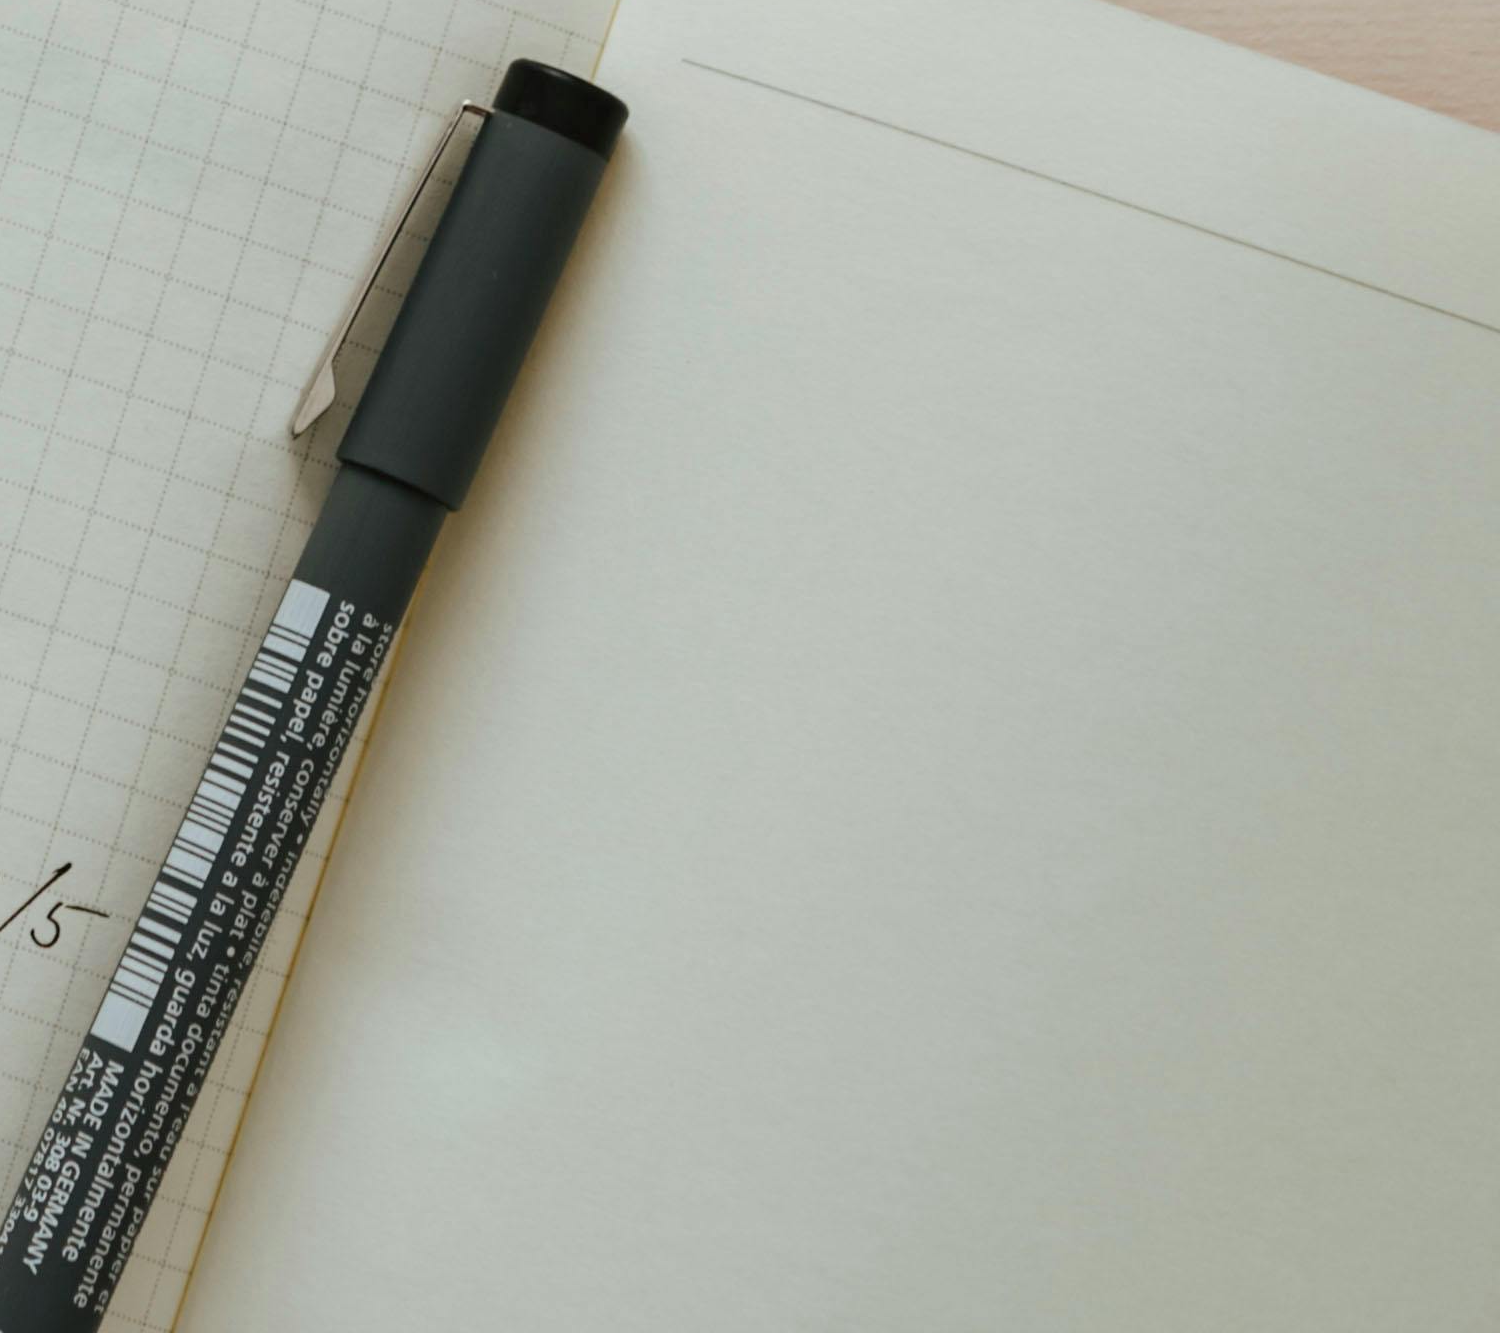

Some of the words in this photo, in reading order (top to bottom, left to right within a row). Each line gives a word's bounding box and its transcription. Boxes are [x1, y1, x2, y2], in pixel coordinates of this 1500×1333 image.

[316, 600, 356, 668] sobre
[350, 633, 373, 655] la
[362, 612, 380, 629] à
[361, 622, 394, 683] store
[279, 669, 325, 743] papel,
[306, 660, 361, 751] lumière,
[299, 686, 367, 824] horizontally
[230, 750, 291, 867] resistente
[261, 758, 315, 869] conserver
[209, 892, 235, 916] la
[221, 870, 239, 888] a
[251, 872, 269, 888] à
[185, 920, 223, 961] luz,
[229, 889, 258, 940] plat
[149, 967, 196, 1057] guarda
[196, 963, 230, 1018] tinta
[193, 977, 244, 1077] résistant
[64, 1047, 88, 1093] EAN
[72, 1050, 104, 1107] Art.
[82, 1059, 125, 1131] MADE
[133, 1023, 203, 1158] documento,
[50, 1097, 67, 1123] 40
[61, 1105, 82, 1126] Nr.
[22, 1128, 53, 1188] 07817
[44, 1130, 72, 1173] 308
[61, 1059, 164, 1262] horizontalmente
[70, 1130, 94, 1160] IN
[22, 1173, 53, 1223] 03-9
[139, 1165, 162, 1203] sur
[22, 1159, 81, 1276] GERMANY
[73, 1163, 142, 1308] permanente
[104, 1206, 144, 1284] papier
